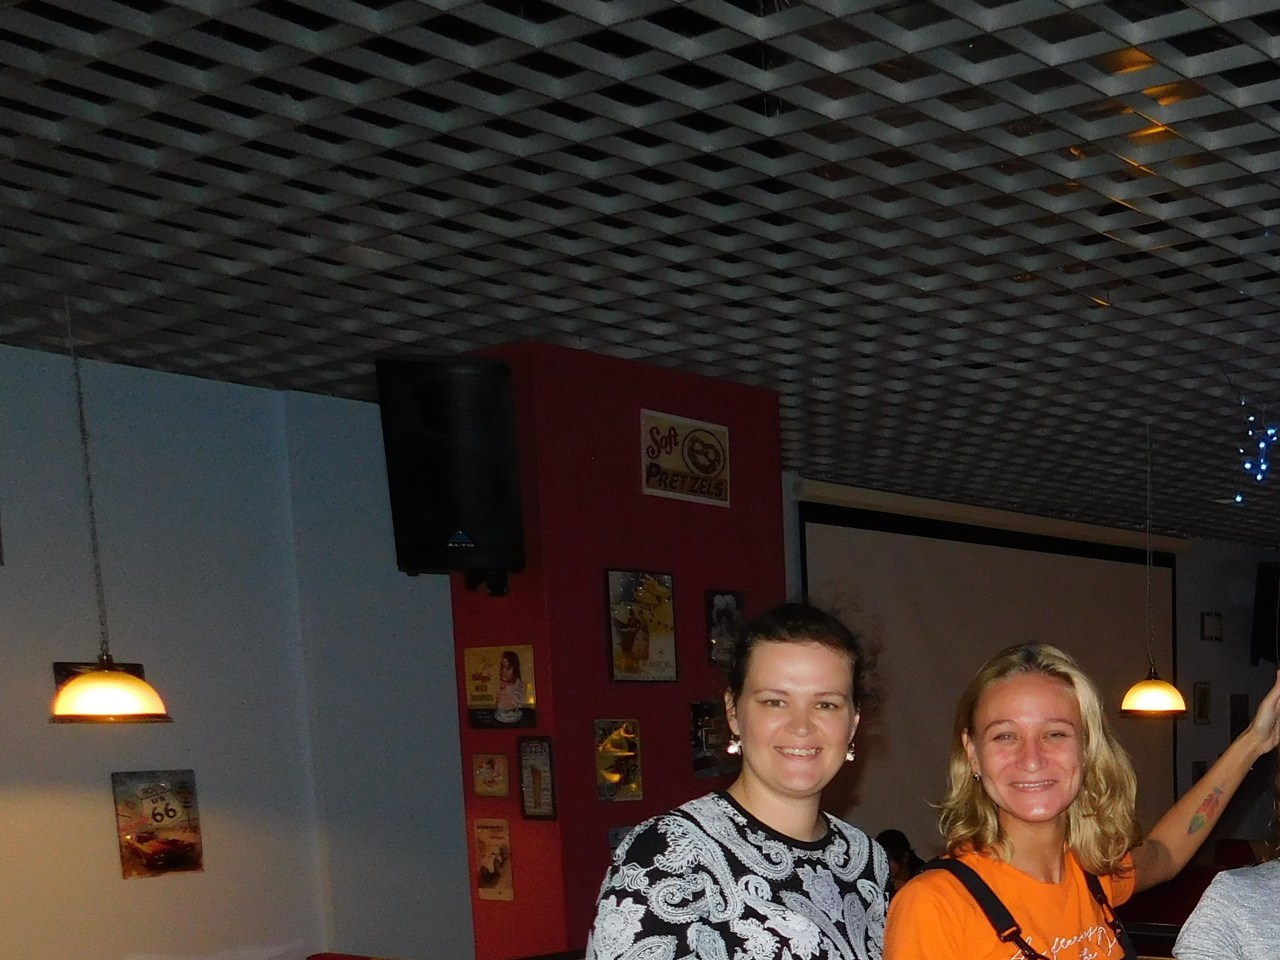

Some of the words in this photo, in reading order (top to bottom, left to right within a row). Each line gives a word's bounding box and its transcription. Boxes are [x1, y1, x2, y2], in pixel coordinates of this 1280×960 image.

[646, 426, 679, 459] Soft
[646, 463, 724, 497] PRETZELS
[152, 803, 177, 823] 66
